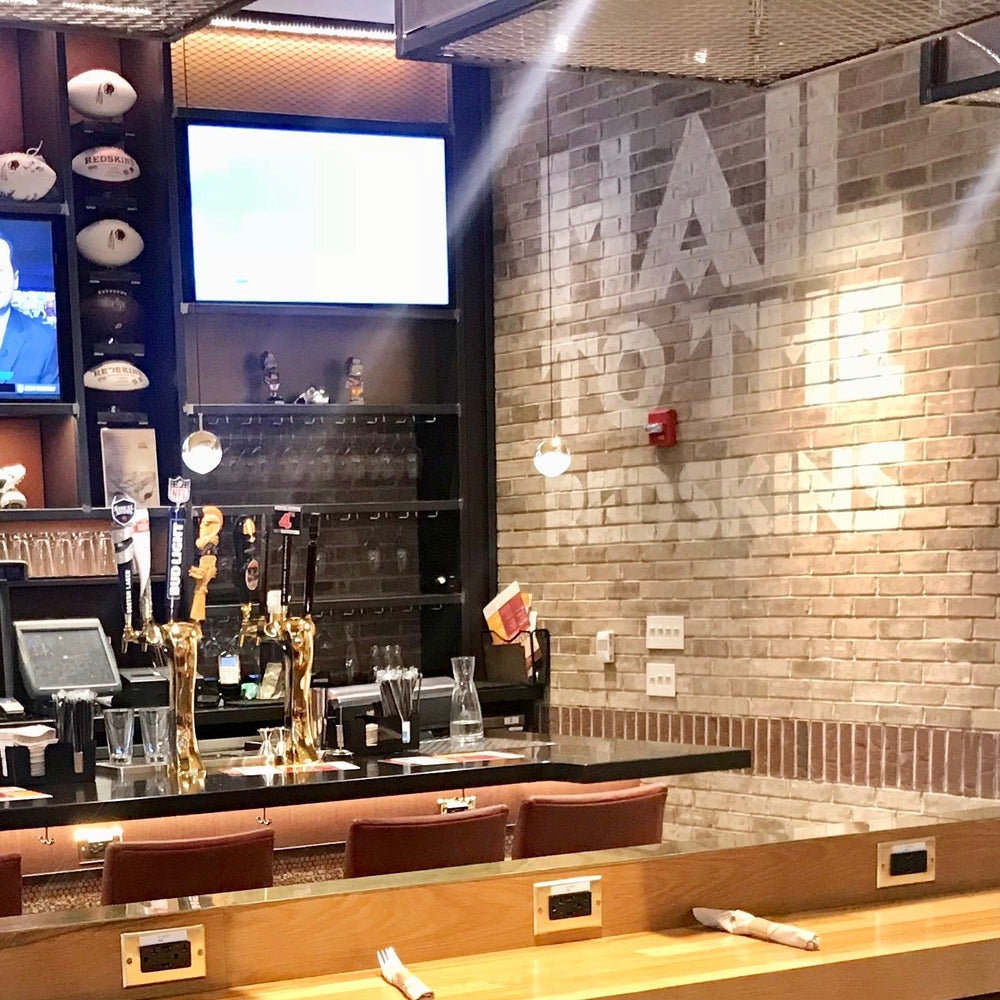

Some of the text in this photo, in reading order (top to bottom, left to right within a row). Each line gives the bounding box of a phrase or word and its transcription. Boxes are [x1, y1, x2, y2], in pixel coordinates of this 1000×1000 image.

[540, 72, 903, 322] HAIL
[541, 284, 905, 434] TO THE
[545, 441, 906, 546] REDSKINS
[169, 521, 184, 597] BUD LIGHT
